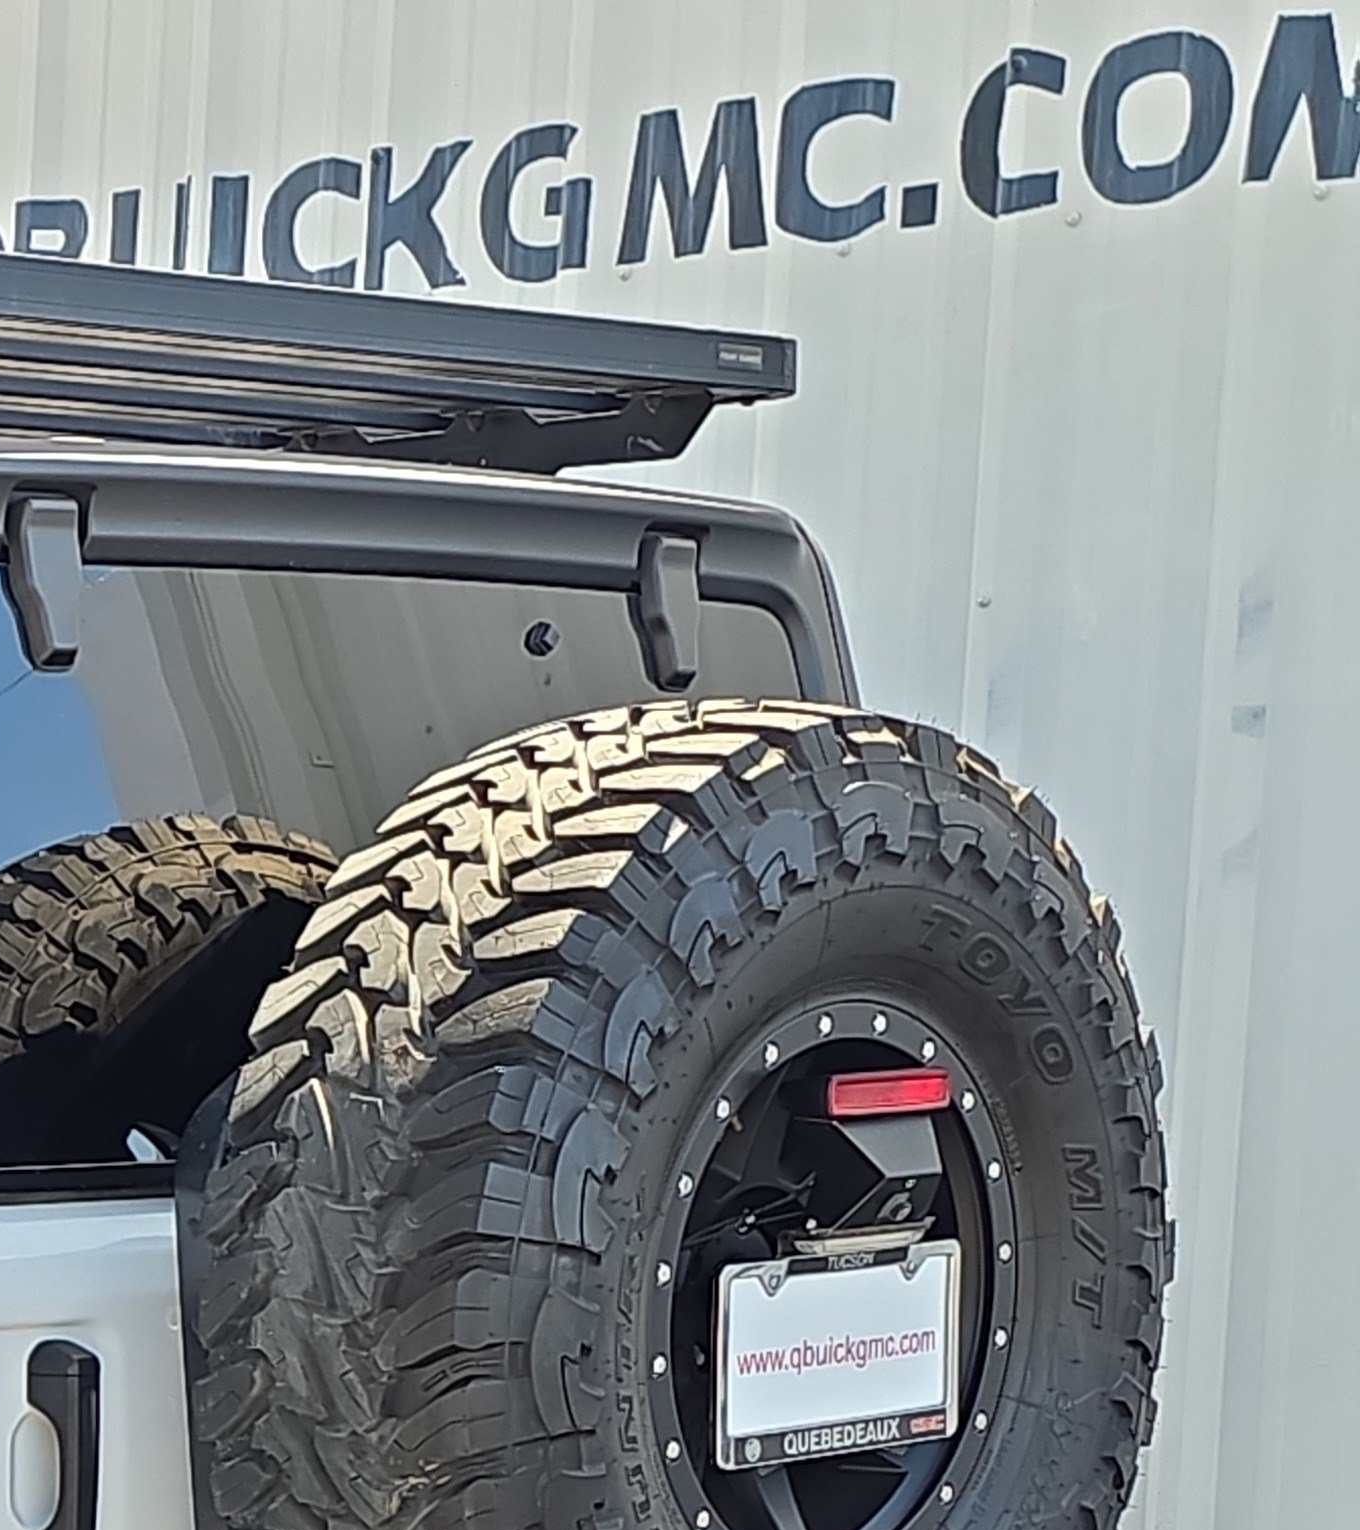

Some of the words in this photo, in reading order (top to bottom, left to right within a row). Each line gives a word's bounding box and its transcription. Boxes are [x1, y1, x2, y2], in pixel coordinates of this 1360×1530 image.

[917, 902, 1077, 1086] TOYO
[1061, 1142, 1109, 1330] M/T
[827, 1252, 877, 1270] TUCSON
[736, 1329, 937, 1376] www.qbuickgmc.com
[783, 1417, 901, 1455] QUEBEDEAUX
